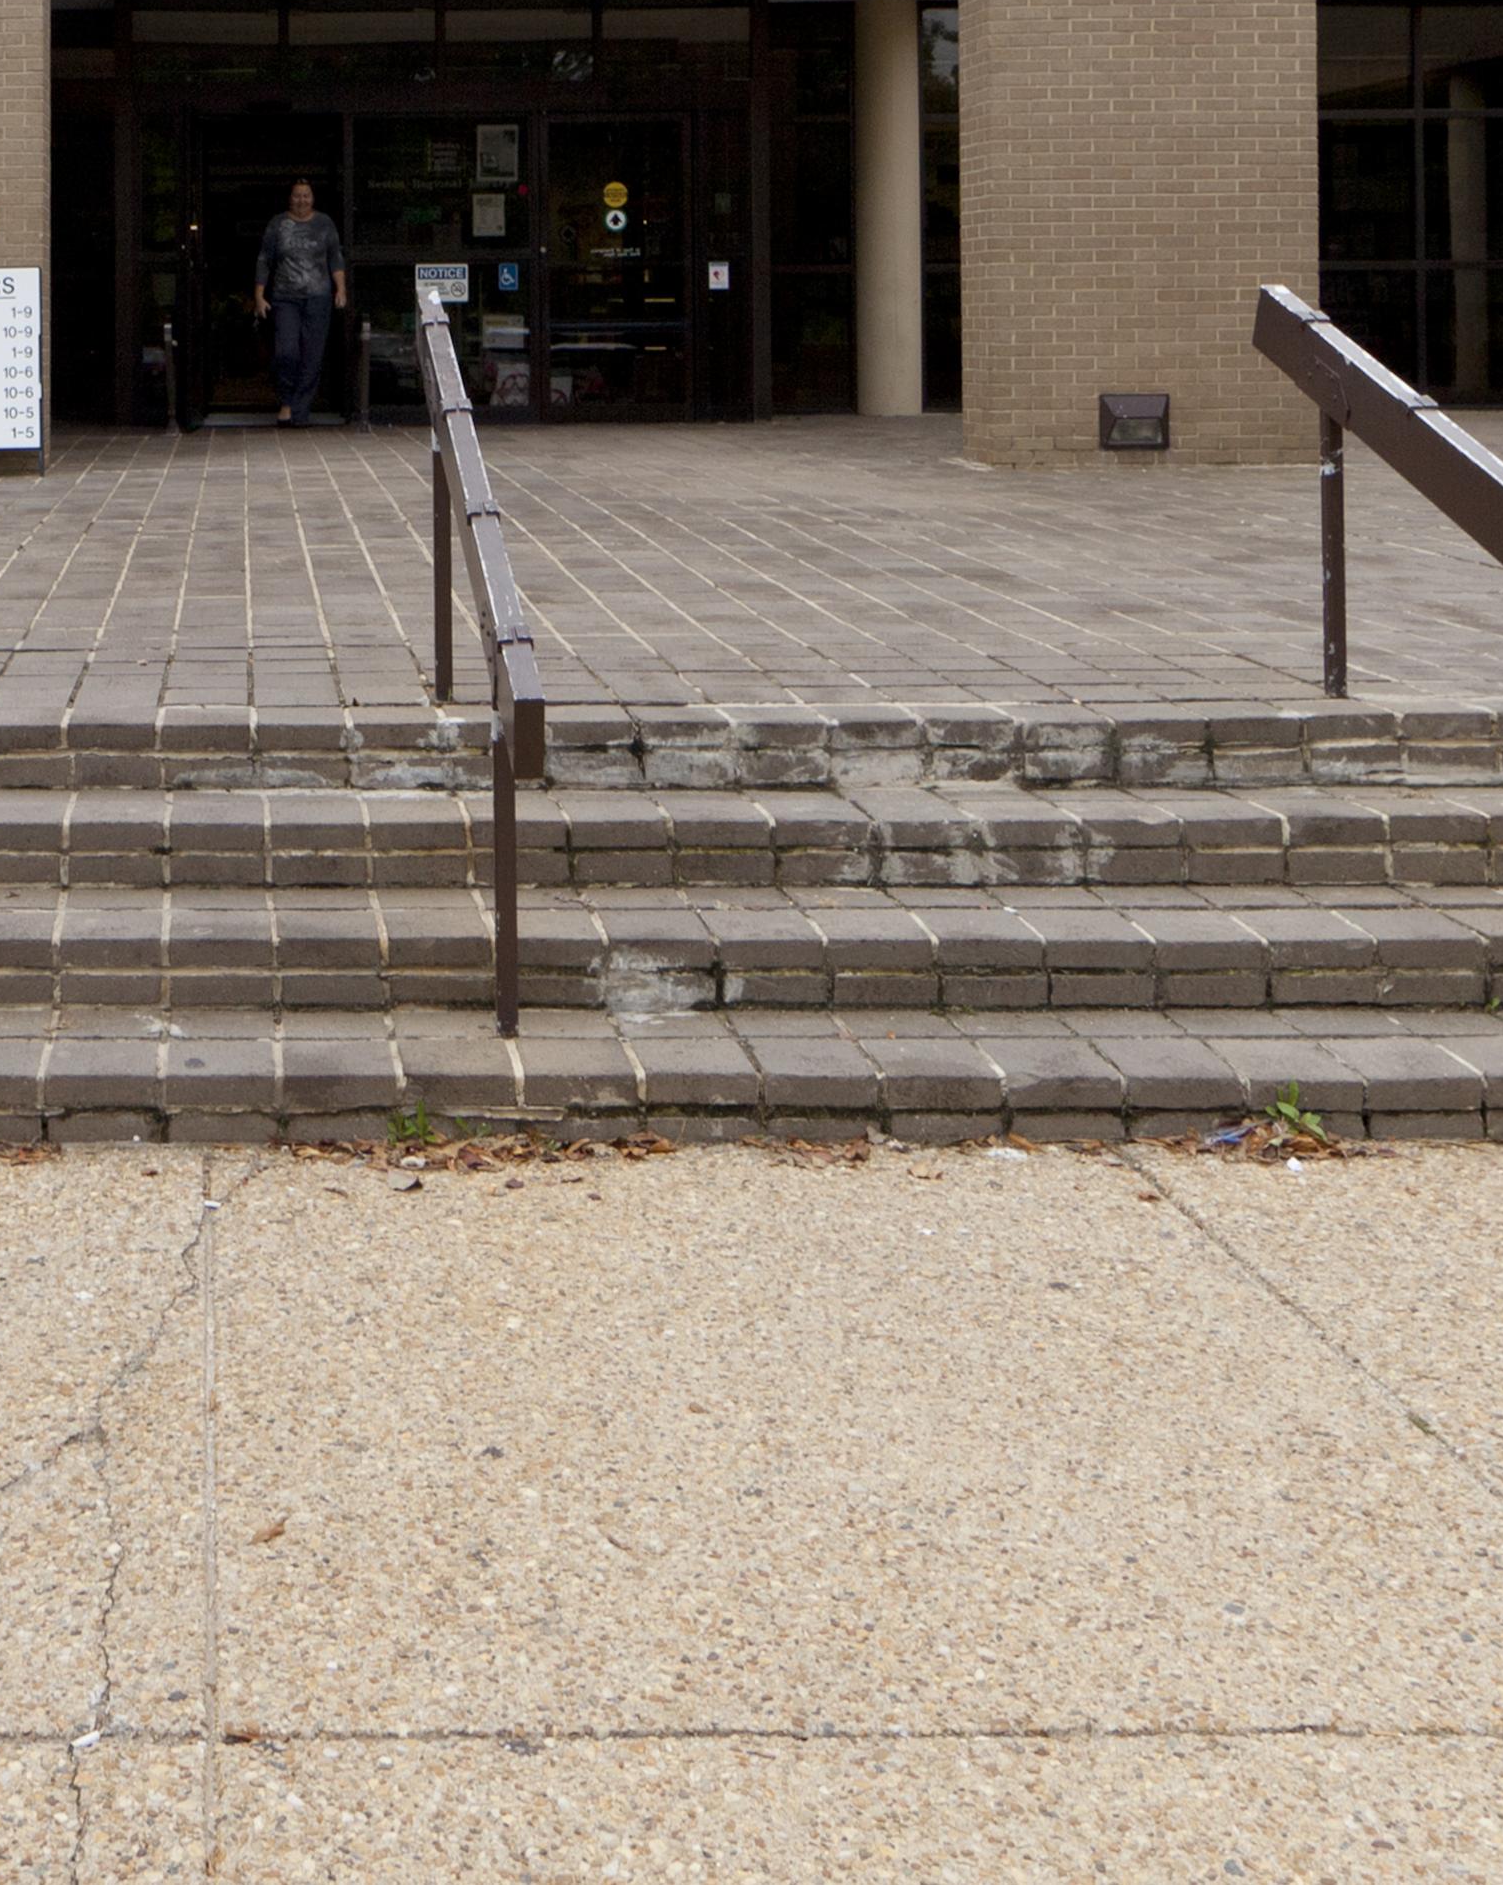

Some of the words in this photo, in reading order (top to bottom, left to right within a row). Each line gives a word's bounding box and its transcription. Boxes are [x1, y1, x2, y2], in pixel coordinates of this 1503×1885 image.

[420, 268, 463, 278] NOTICE
[12, 306, 32, 318] 1-9
[3, 326, 33, 338] 10-9
[12, 346, 33, 358] 1-9
[4, 366, 33, 379] 10-6
[4, 386, 34, 399] 10-6
[4, 407, 34, 419] 10-5
[12, 427, 34, 438] 1-5
